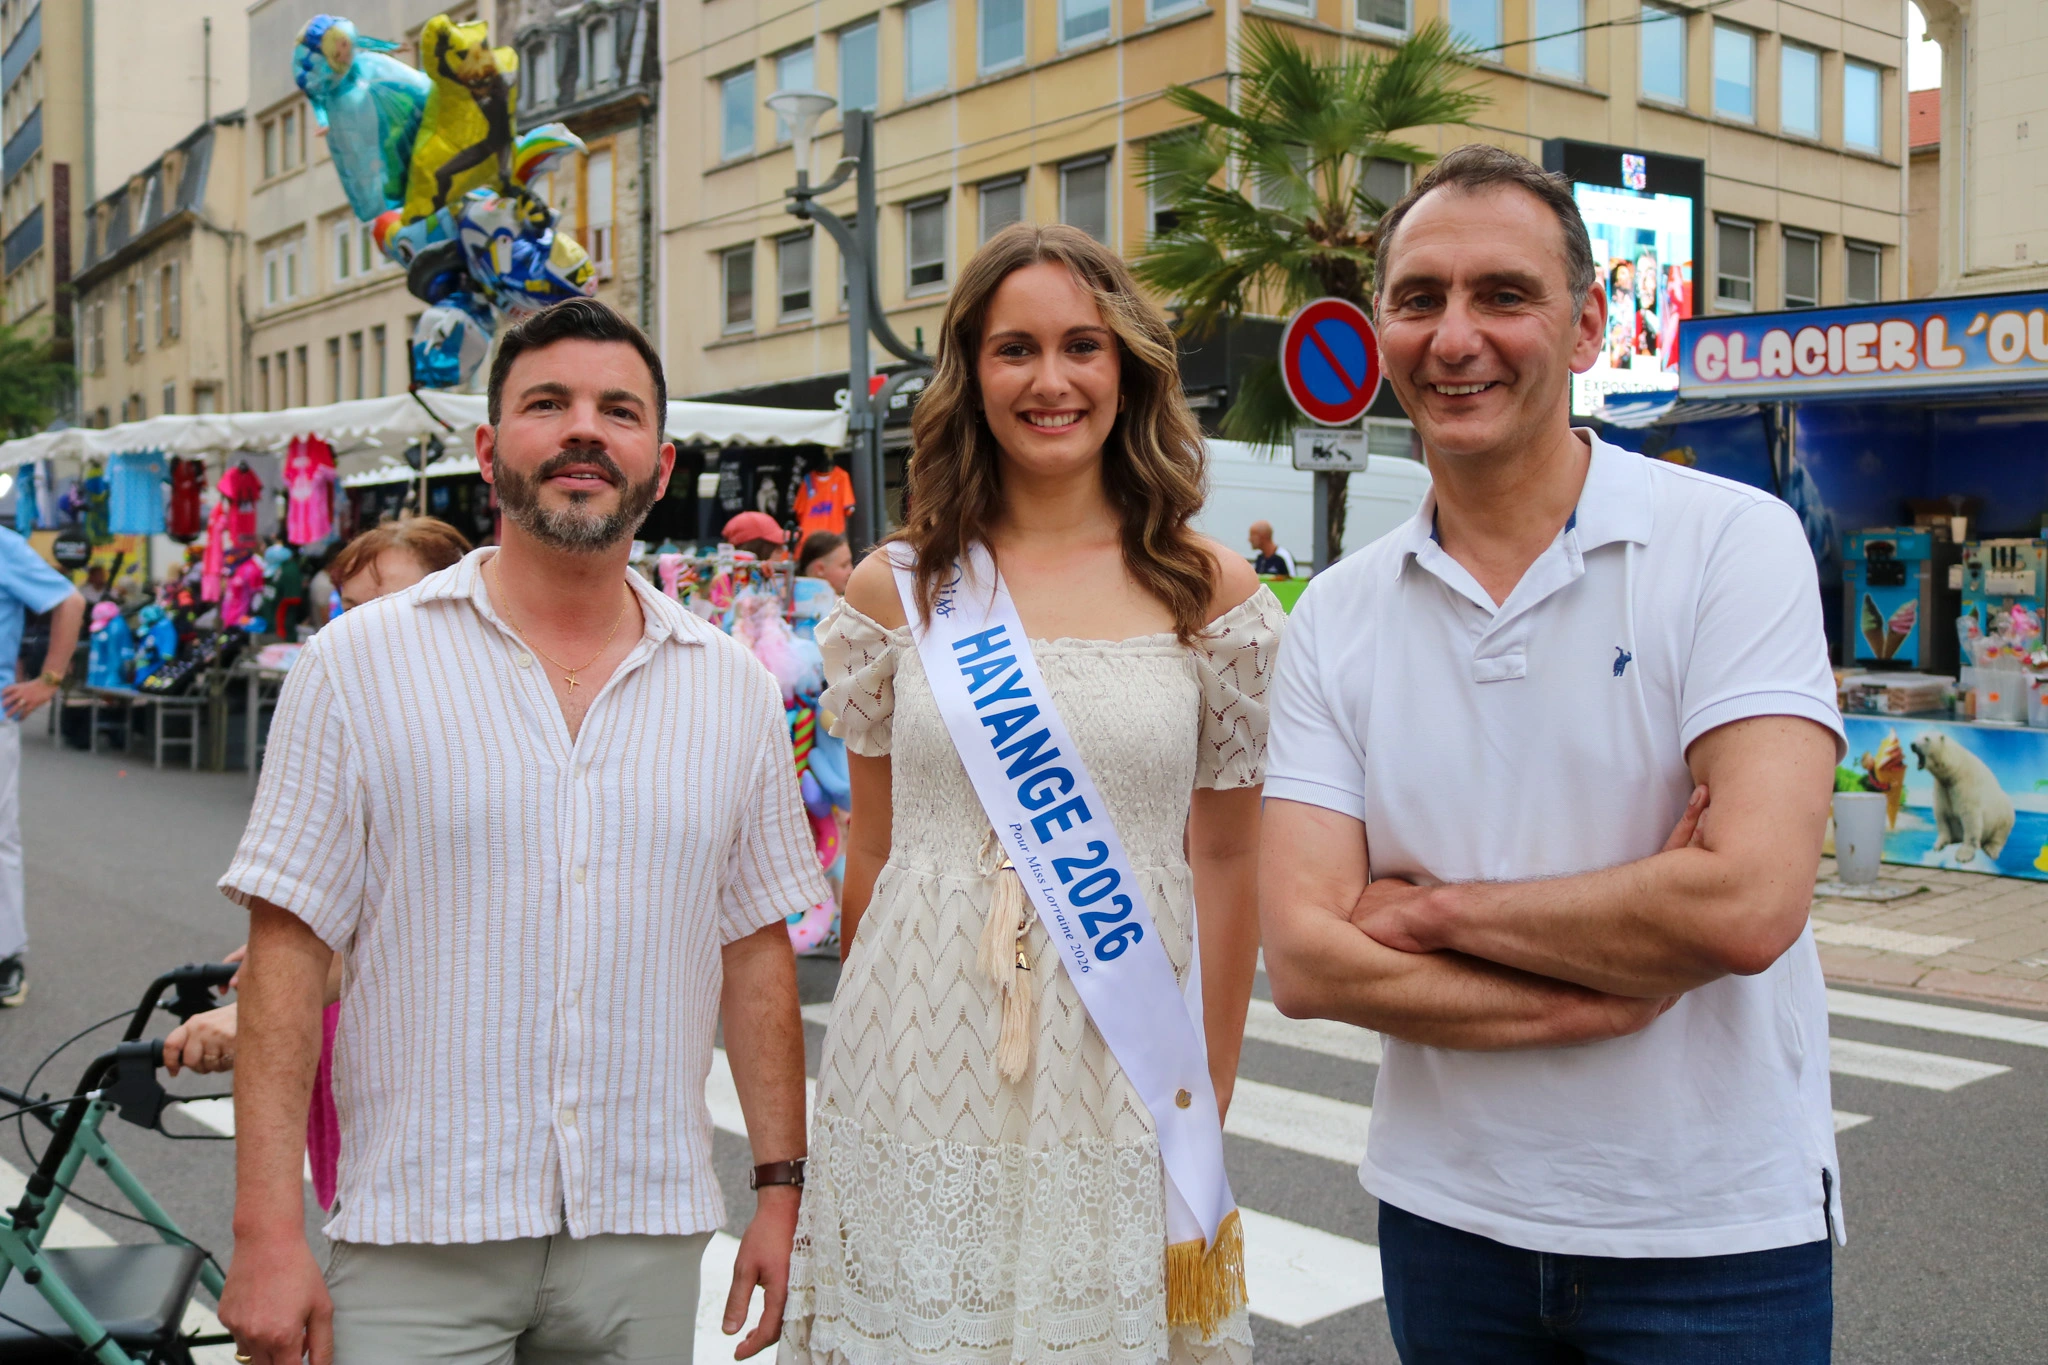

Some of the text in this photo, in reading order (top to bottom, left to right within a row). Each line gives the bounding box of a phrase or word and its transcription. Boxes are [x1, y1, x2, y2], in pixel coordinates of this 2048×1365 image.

[1694, 319, 1917, 381] GLACIER
[952, 624, 1144, 962] HAYANGE 2026
[1009, 822, 1093, 974] Pour Miss Lorraine 2026
